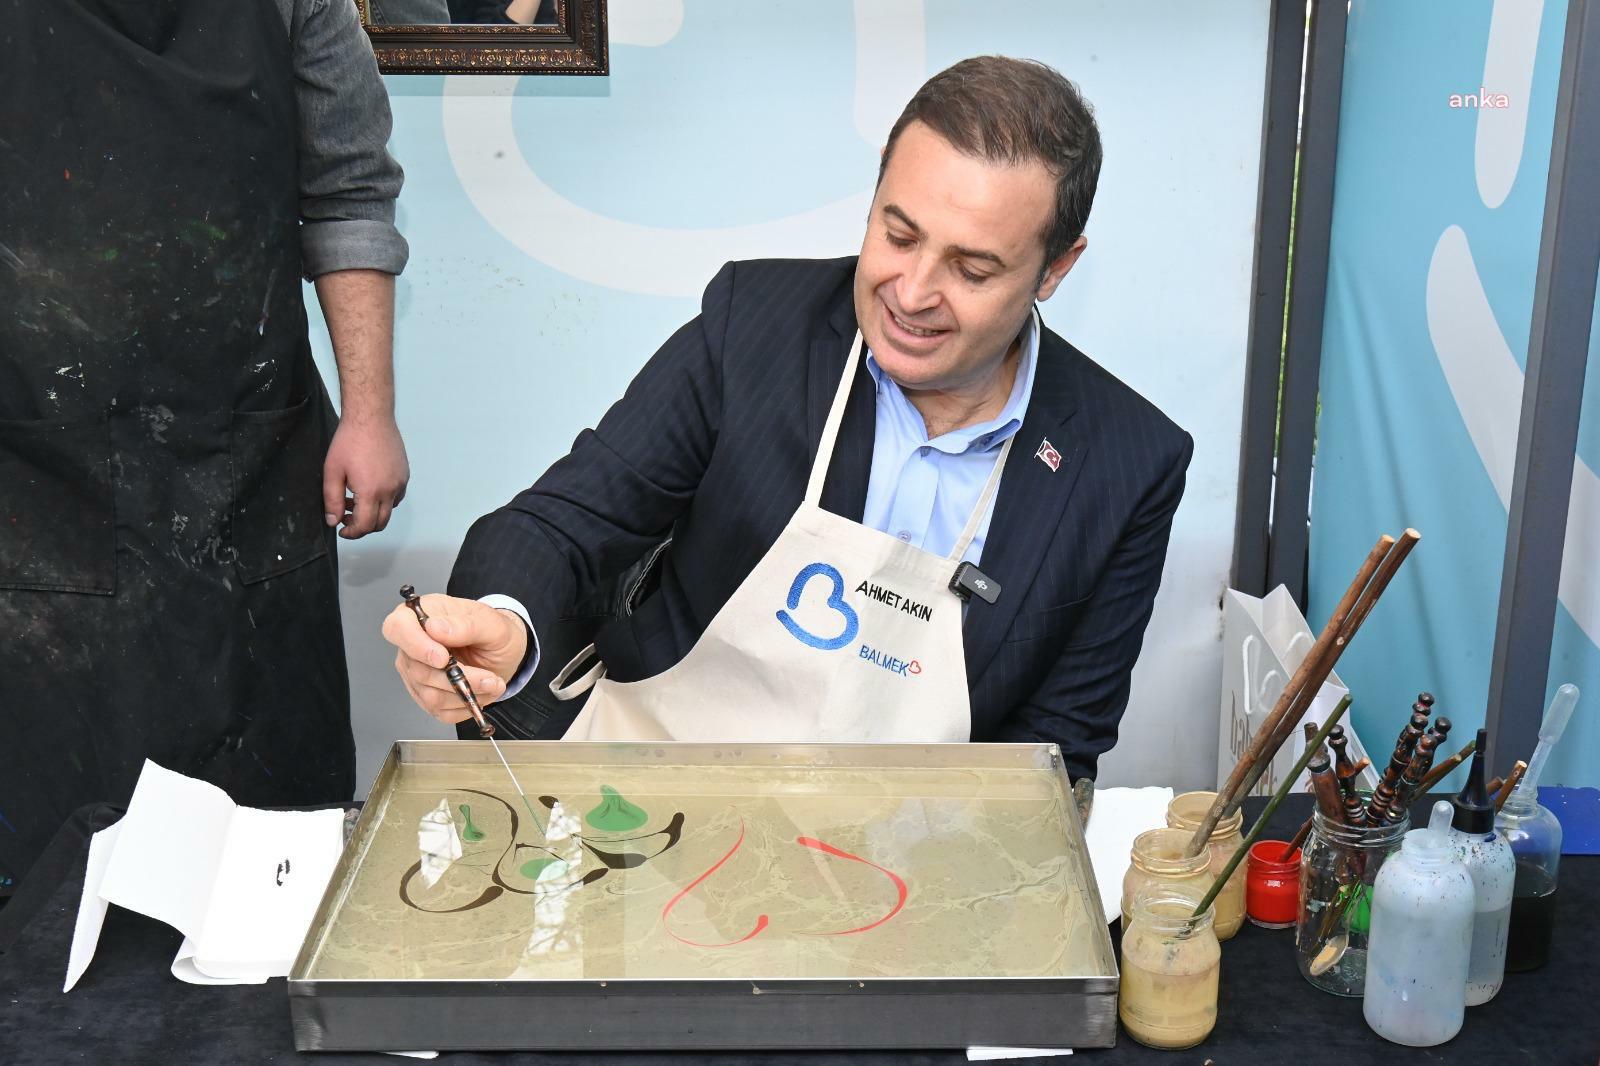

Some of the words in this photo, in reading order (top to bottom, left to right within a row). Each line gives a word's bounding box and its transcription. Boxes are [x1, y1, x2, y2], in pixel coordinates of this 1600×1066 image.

[855, 580, 902, 608] AHMET
[901, 598, 933, 622] AKIN
[859, 644, 909, 677] BALMEK
